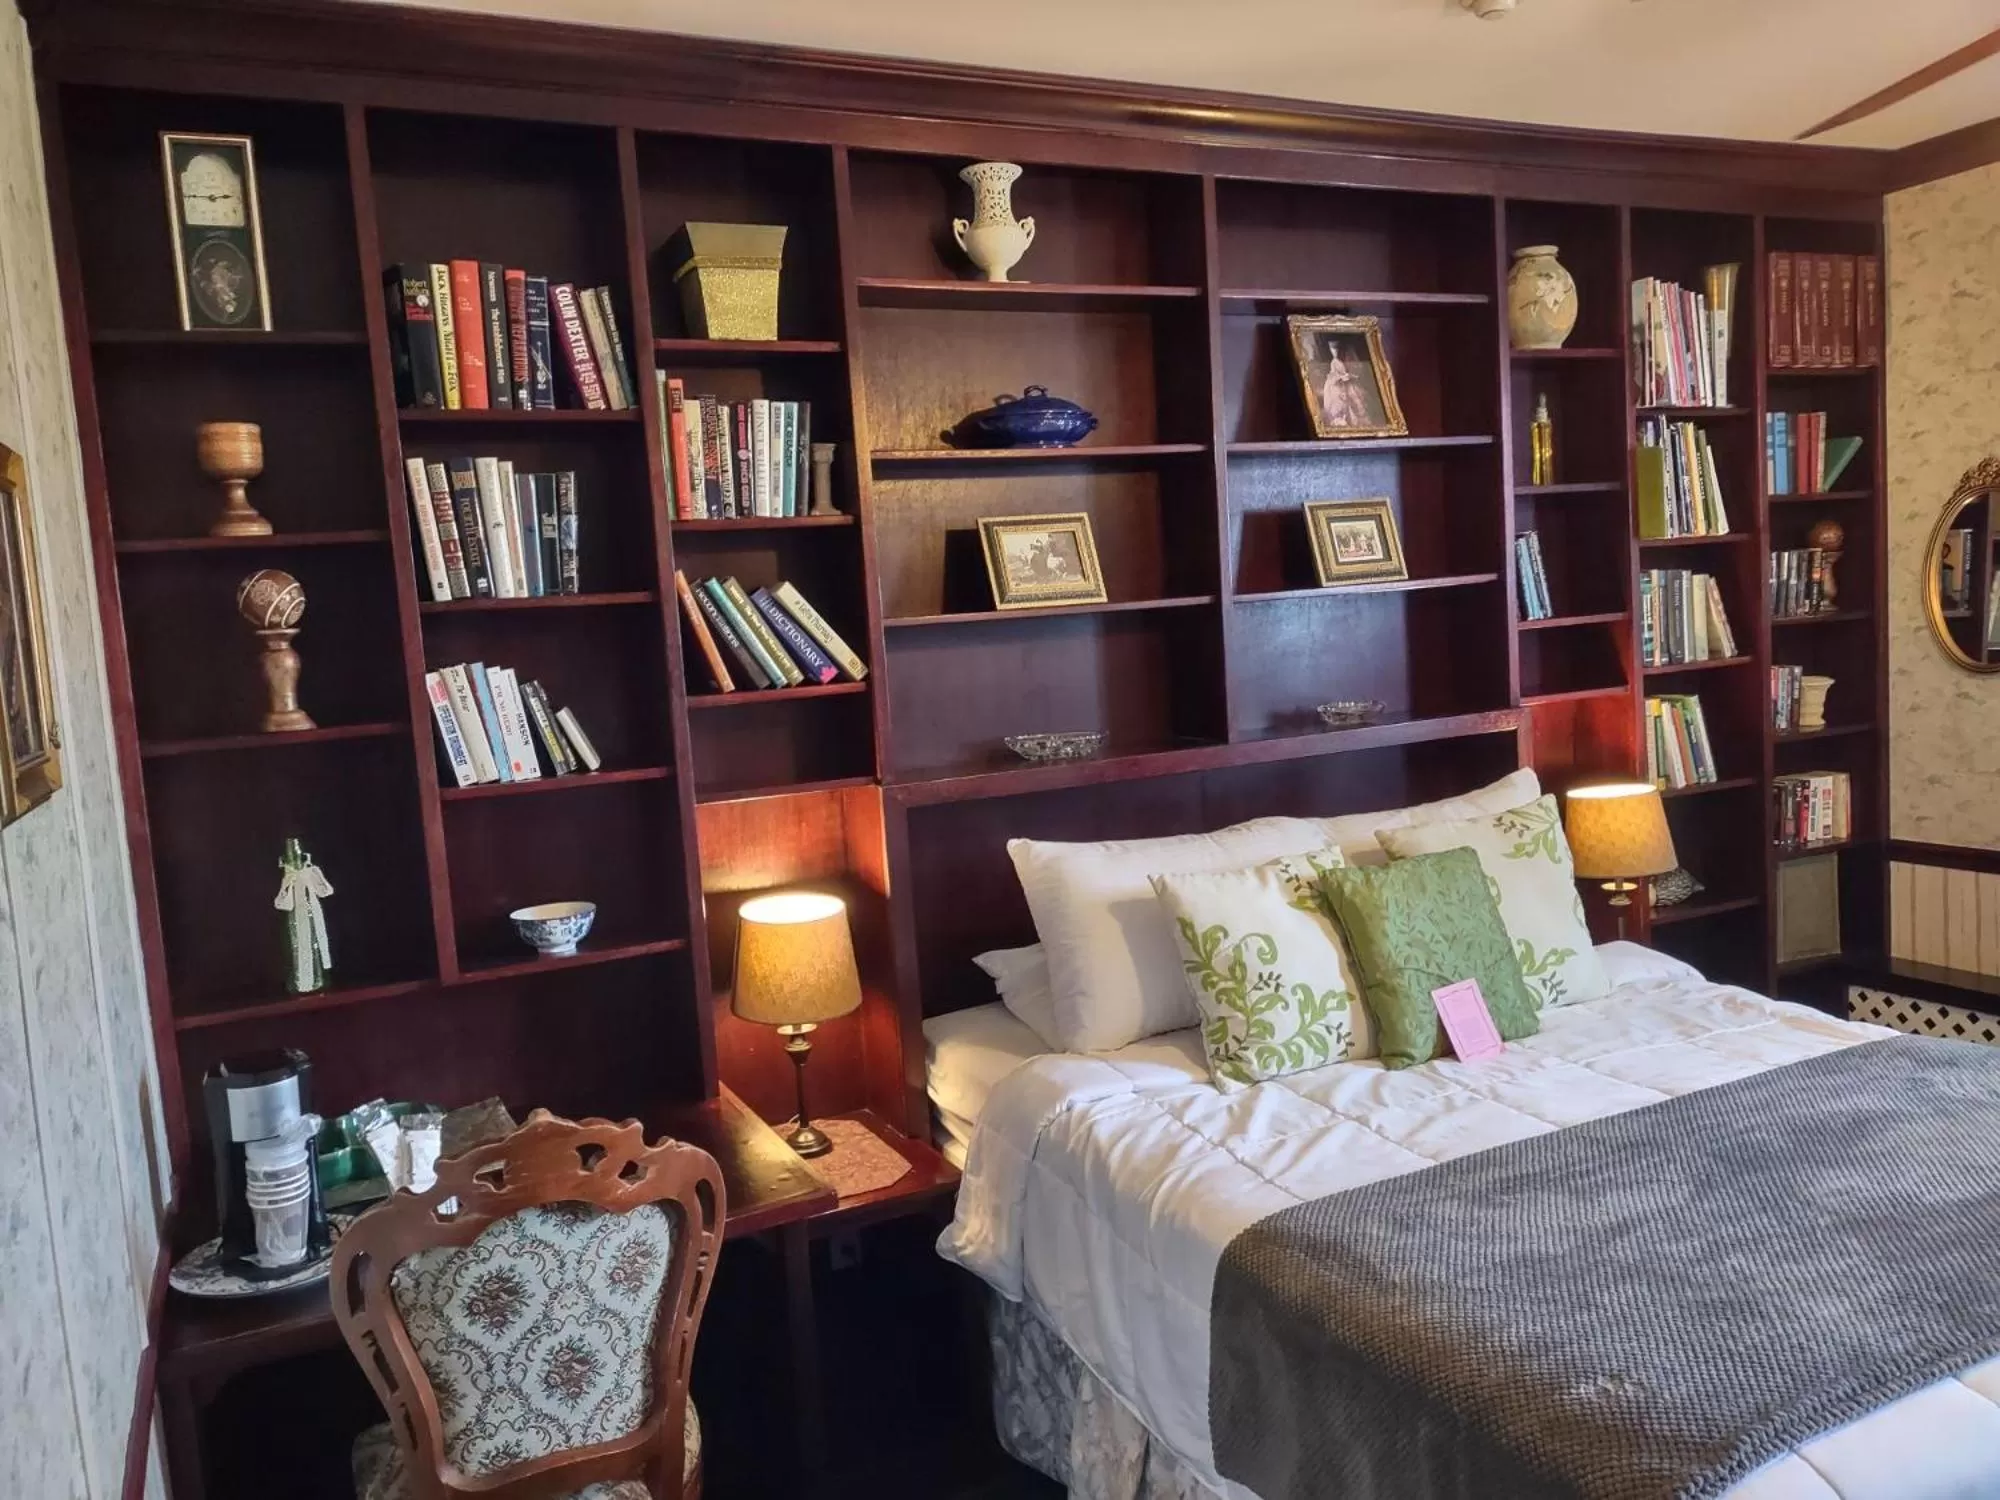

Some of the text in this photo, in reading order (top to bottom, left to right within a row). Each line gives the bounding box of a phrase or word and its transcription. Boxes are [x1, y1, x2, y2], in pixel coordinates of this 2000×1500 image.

[554, 284, 589, 362] COLIN DEXTER
[740, 461, 748, 483] INCA
[768, 605, 823, 668] DICTIONARY
[515, 712, 530, 745] HANSON
